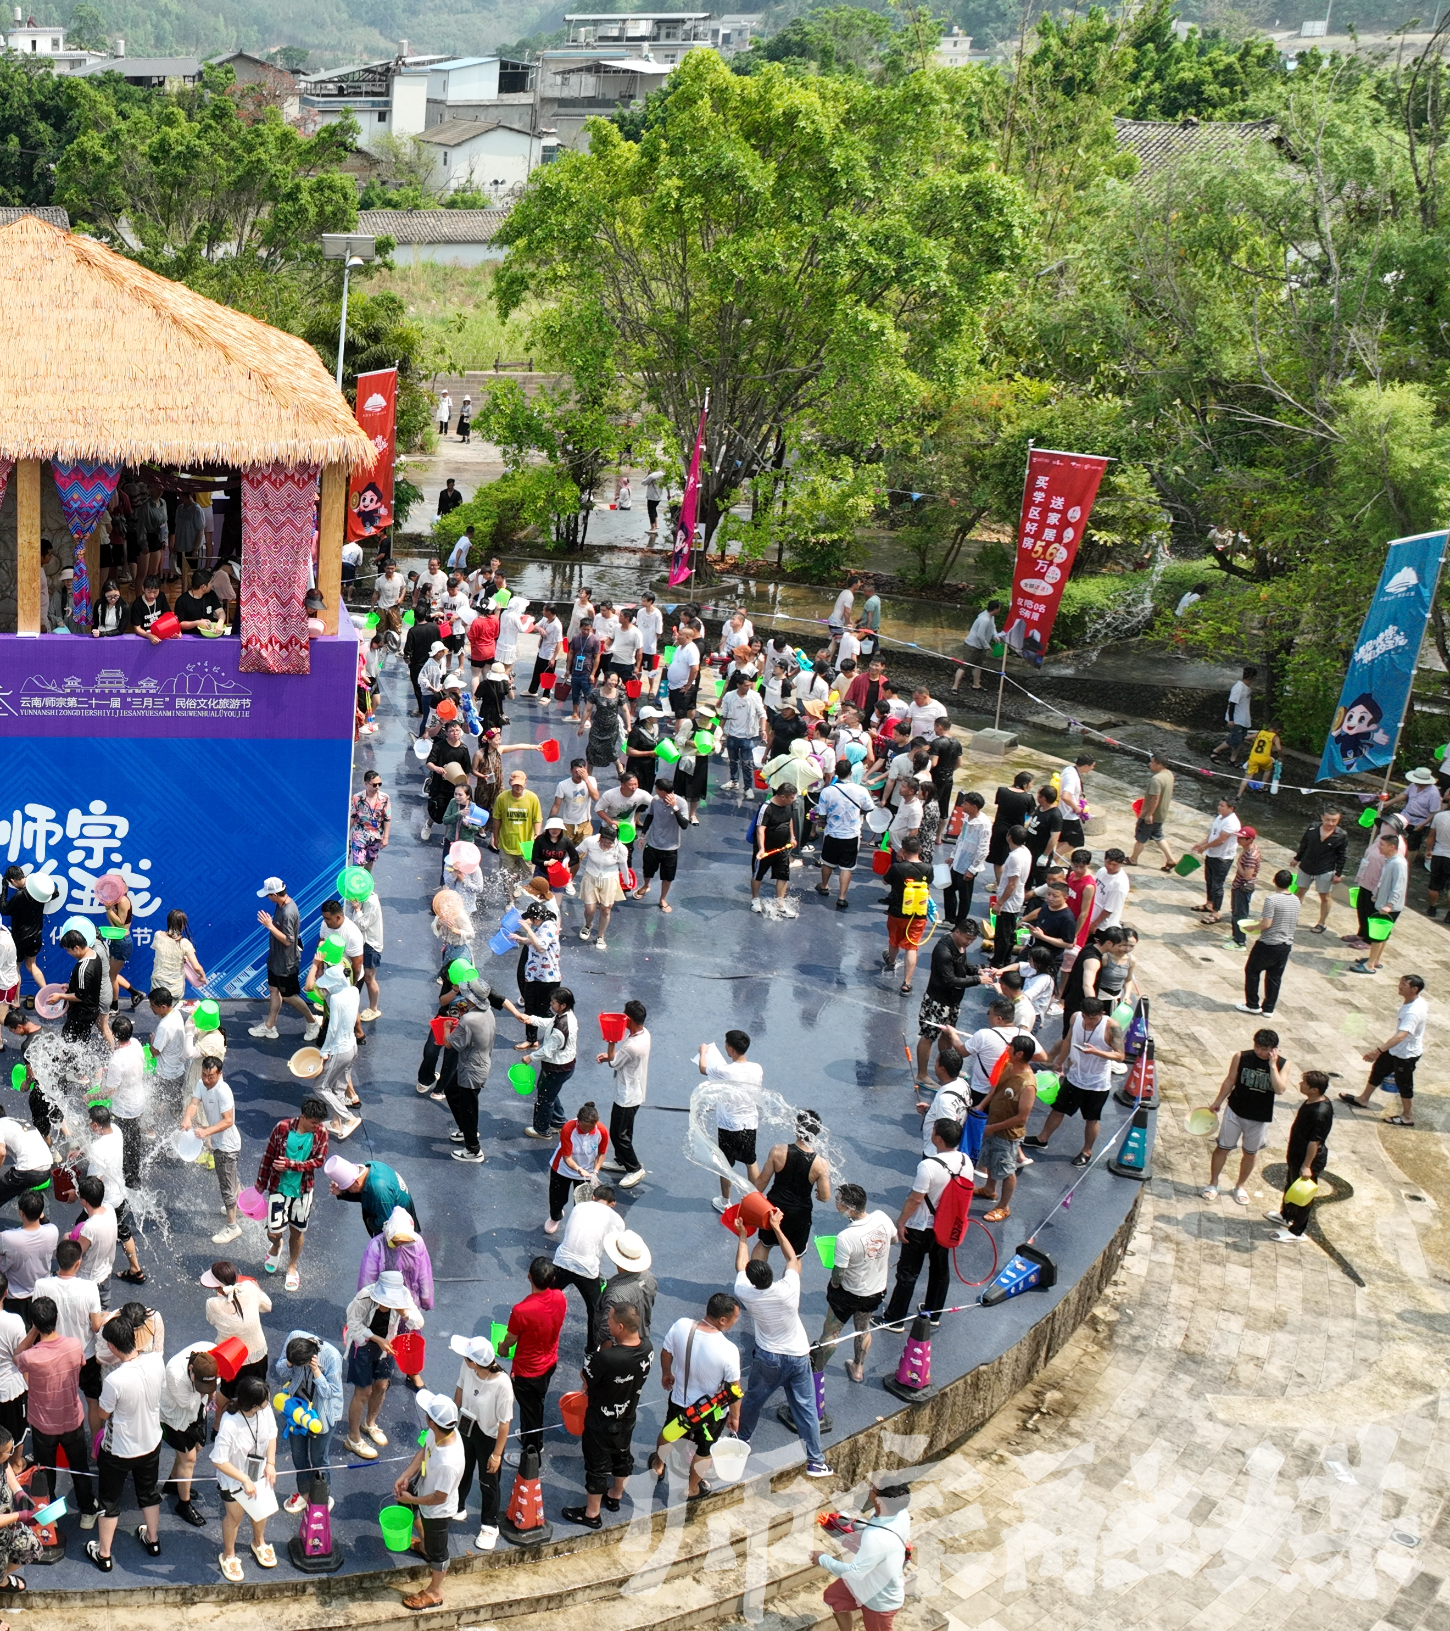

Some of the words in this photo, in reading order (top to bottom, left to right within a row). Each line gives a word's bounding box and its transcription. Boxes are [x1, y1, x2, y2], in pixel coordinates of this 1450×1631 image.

[1022, 475, 1050, 551] 买学区好房
[1255, 739, 1266, 754] 8
